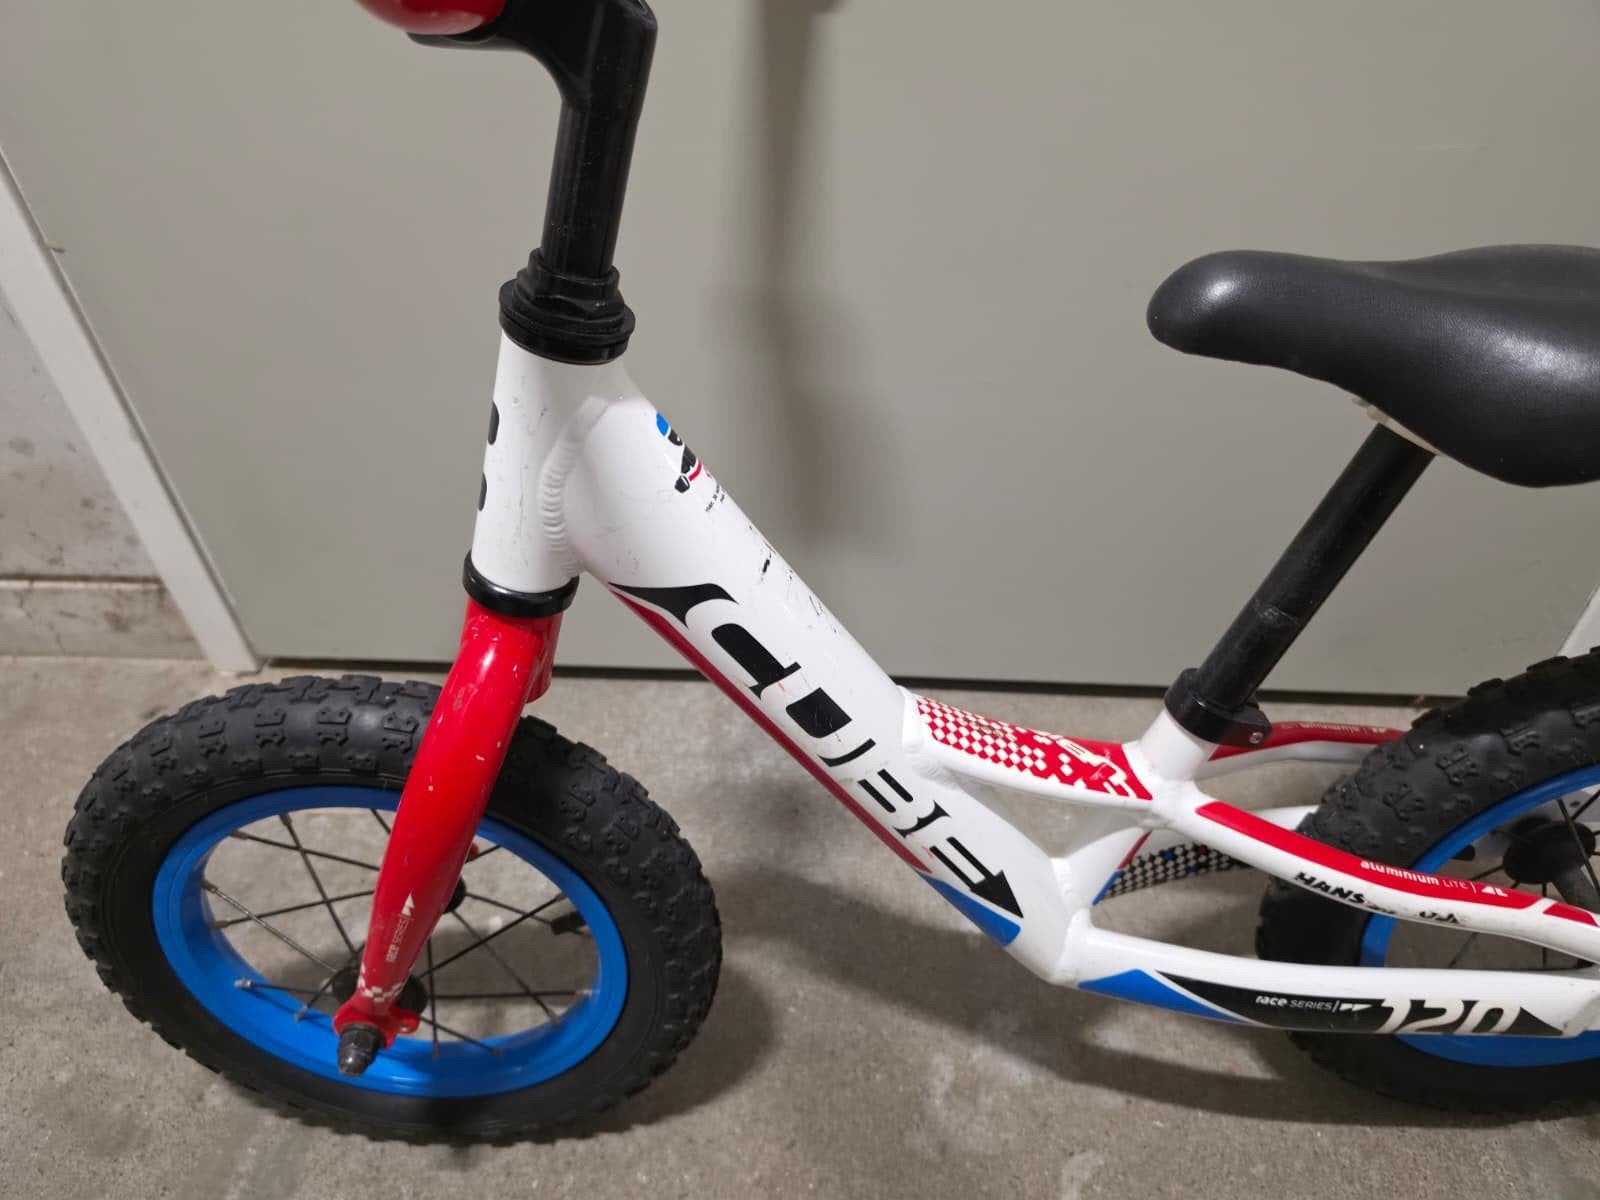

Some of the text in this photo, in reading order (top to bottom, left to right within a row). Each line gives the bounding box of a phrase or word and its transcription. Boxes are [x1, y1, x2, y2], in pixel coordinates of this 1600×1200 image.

[645, 584, 1022, 917] CUBE
[1360, 859, 1440, 886] aluminium
[1442, 878, 1469, 890] LITE
[1255, 995, 1522, 1034] race SERIES 120
